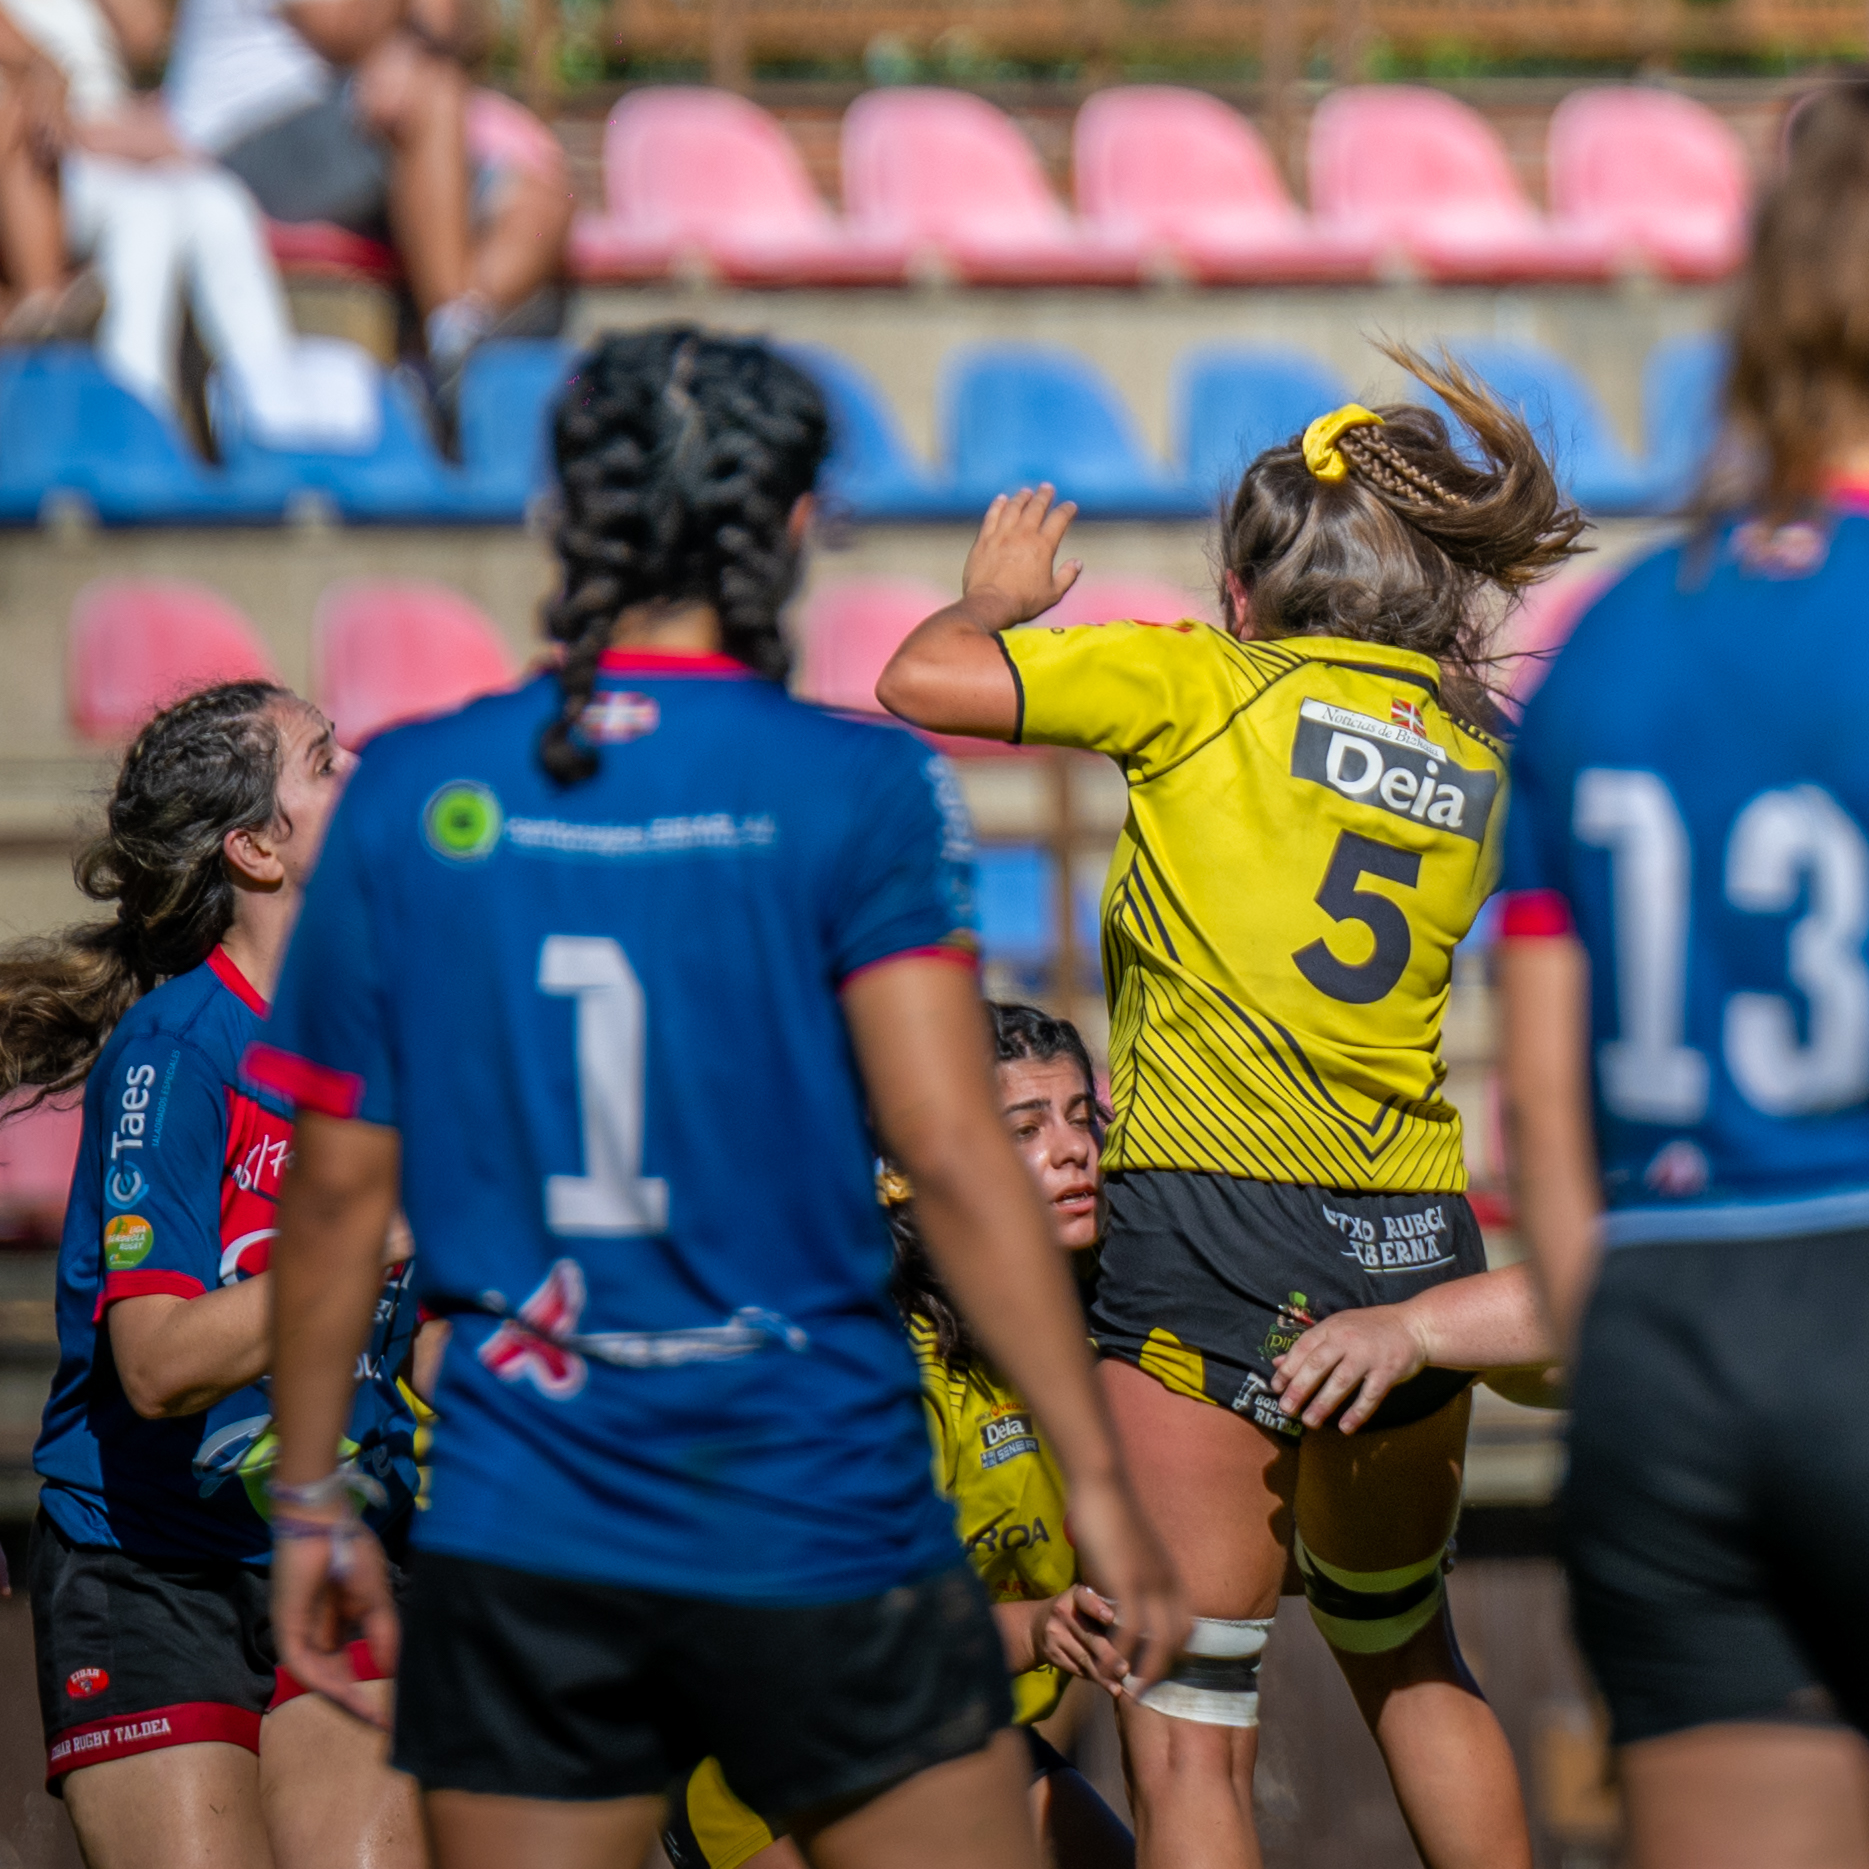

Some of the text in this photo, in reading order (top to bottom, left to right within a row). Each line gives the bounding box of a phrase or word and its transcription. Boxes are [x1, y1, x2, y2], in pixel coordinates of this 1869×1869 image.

[1378, 725, 1392, 739] de
[1326, 731, 1466, 828] Deia
[1291, 828, 1424, 1004] 5
[111, 1063, 156, 1161] Taes
[537, 934, 669, 1236] 1
[986, 1416, 1025, 1446] Deia
[996, 1439, 1038, 1462] SENER
[73, 1729, 111, 1753] RUGBY
[114, 1717, 172, 1745] TALDEA
